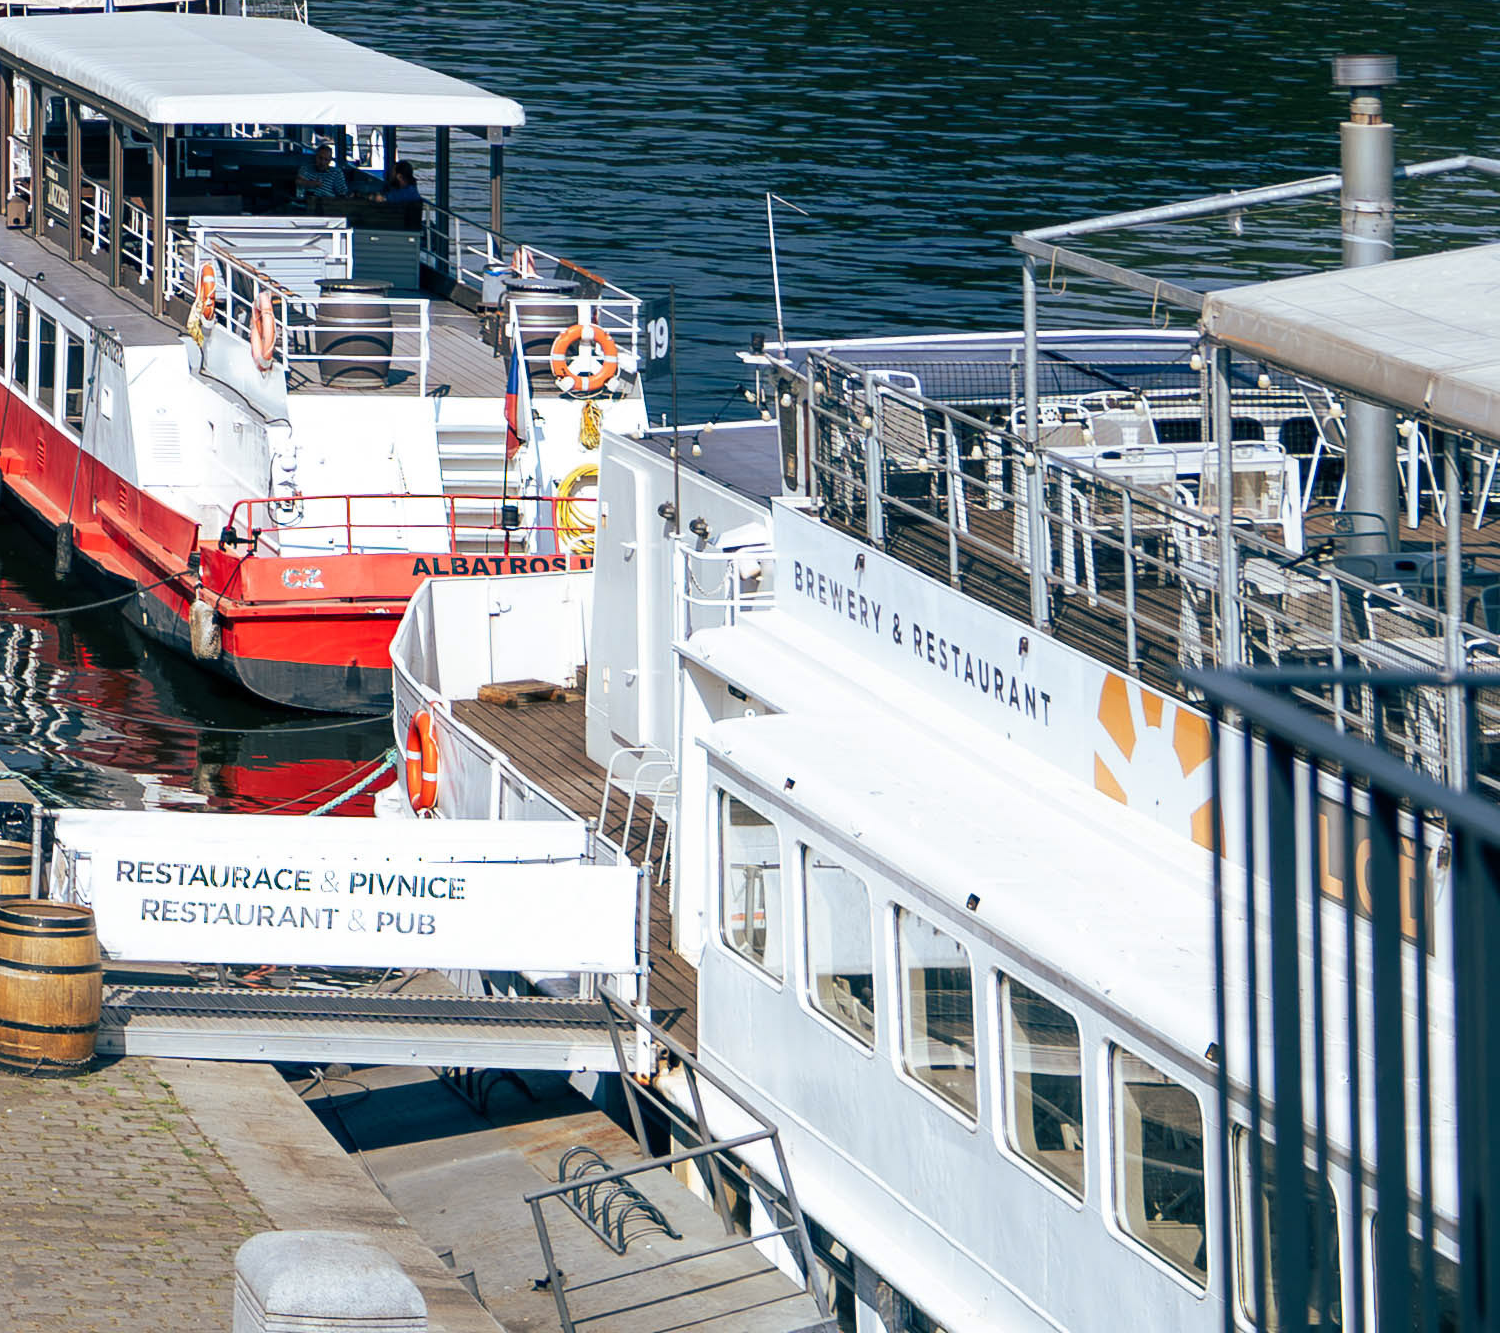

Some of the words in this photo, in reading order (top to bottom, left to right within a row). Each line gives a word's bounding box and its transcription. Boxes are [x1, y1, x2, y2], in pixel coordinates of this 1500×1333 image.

[647, 316, 669, 360] 19
[280, 567, 325, 589] CZ
[411, 556, 567, 577] ALBATROS
[793, 559, 882, 634] BREWERY
[892, 612, 903, 646] &
[912, 622, 1052, 727] RESTAURANT
[116, 859, 312, 893] RESTAURACE
[320, 870, 341, 894] &
[349, 871, 466, 901] PIVNICE
[140, 898, 340, 931] RESTAURANT
[347, 909, 368, 933] &
[376, 910, 438, 936] PUB
